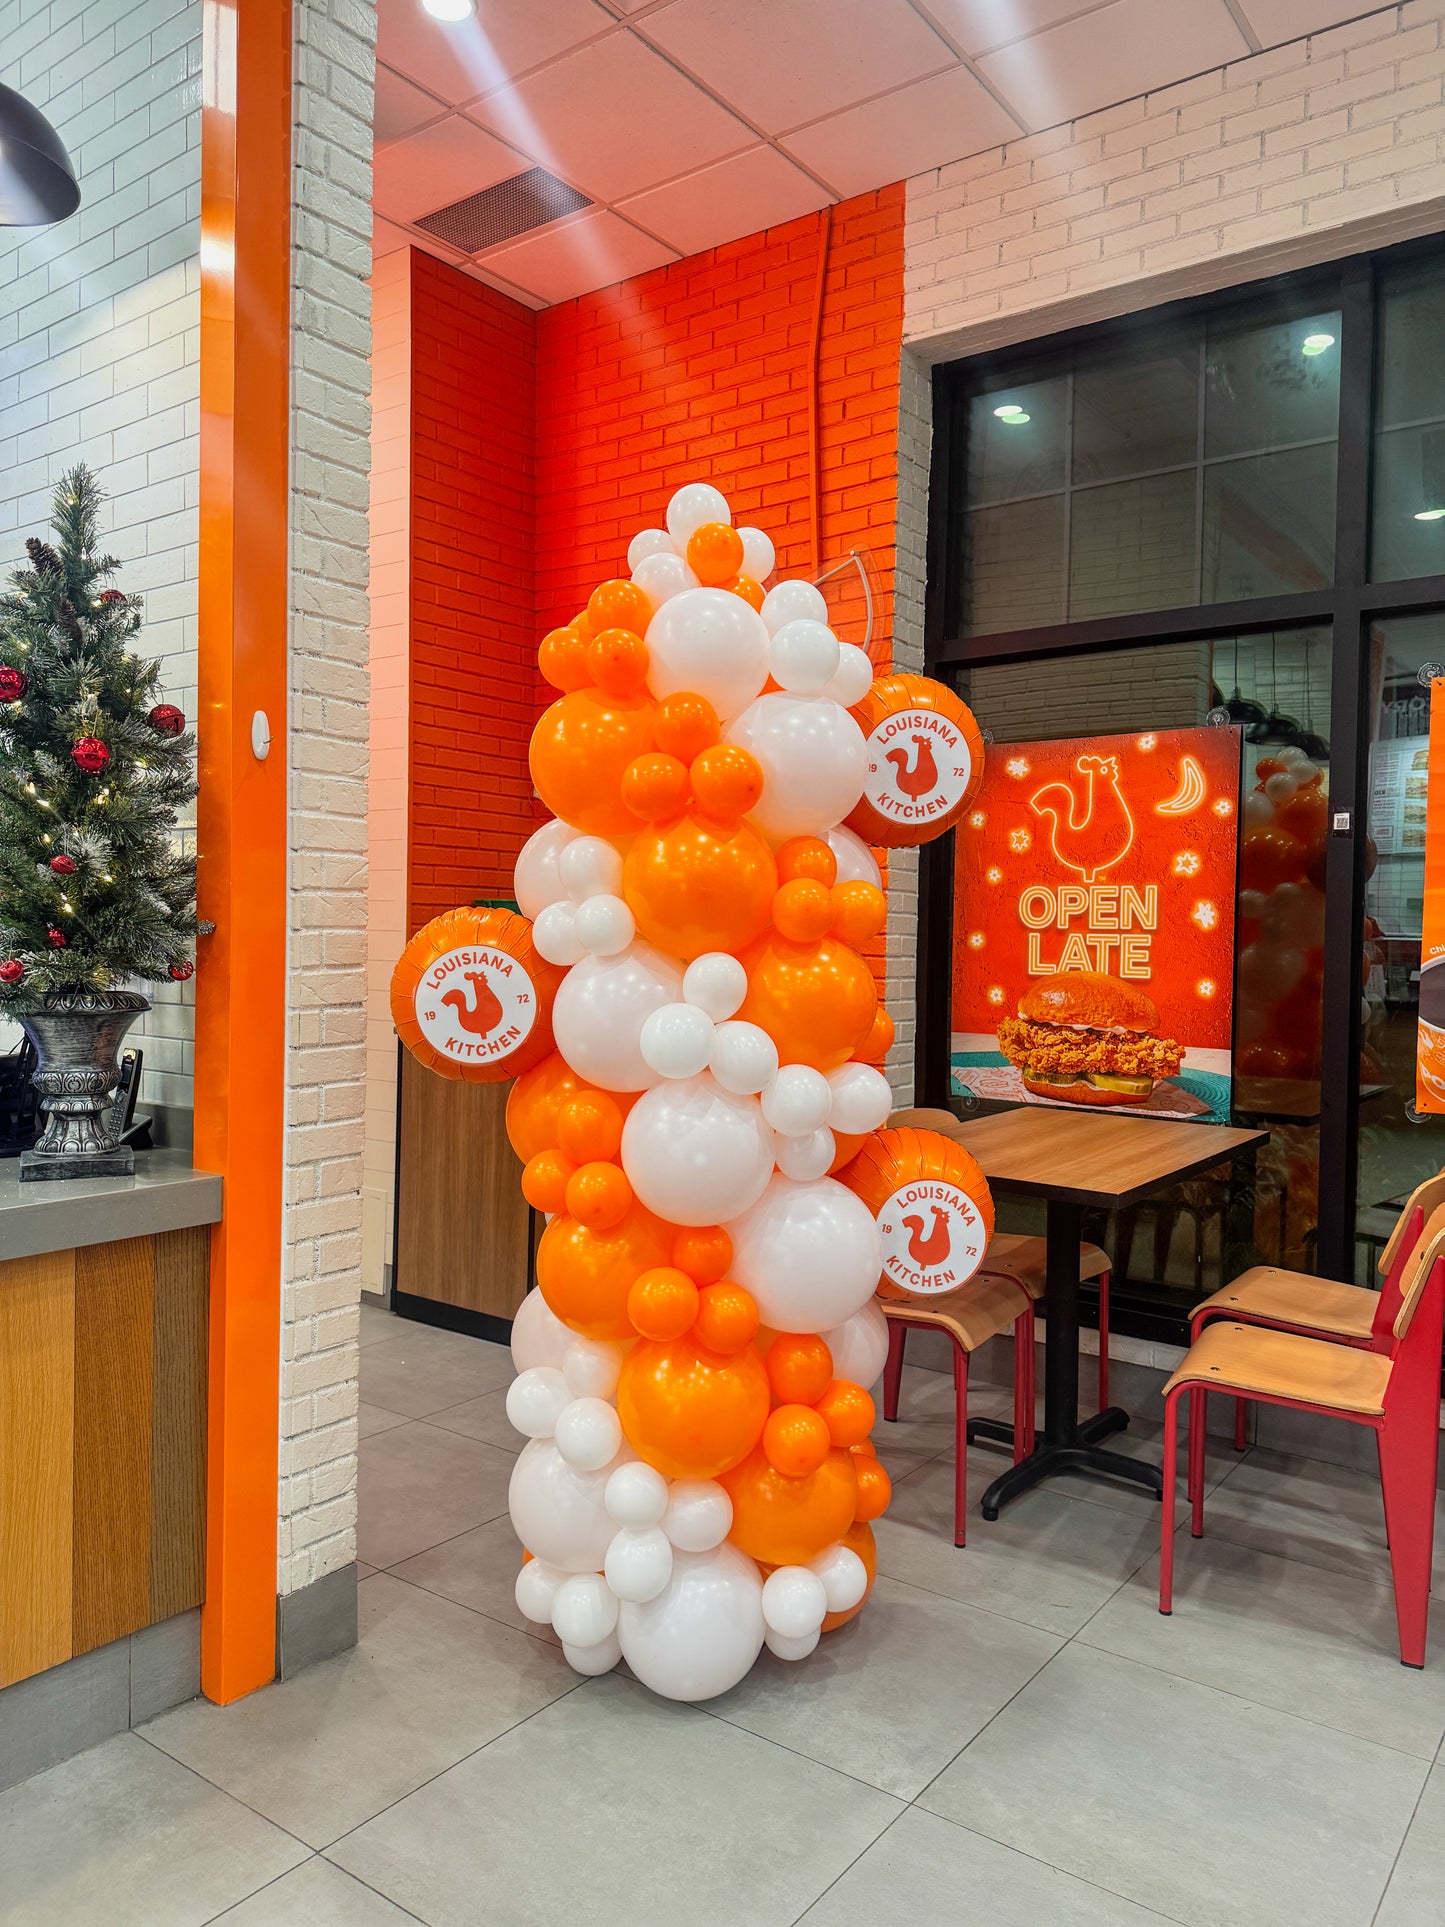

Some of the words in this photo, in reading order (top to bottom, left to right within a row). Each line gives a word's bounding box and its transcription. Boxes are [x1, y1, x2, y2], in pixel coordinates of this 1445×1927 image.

[876, 715, 958, 749] LOUISIANA
[953, 767, 965, 777] 72
[876, 792, 949, 818] KITCHEN
[1018, 885, 1158, 930] OPEN
[426, 951, 514, 990] LOUISIANA
[1028, 932, 1152, 979] LATE
[516, 993, 530, 1005] 72
[424, 1010, 437, 1021] 19
[444, 1025, 522, 1057] KITCHEN
[896, 1186, 976, 1227] LOUISIANA
[881, 1223, 893, 1234] 19
[965, 1245, 977, 1257] 72
[885, 1255, 956, 1288] KITCHEN
